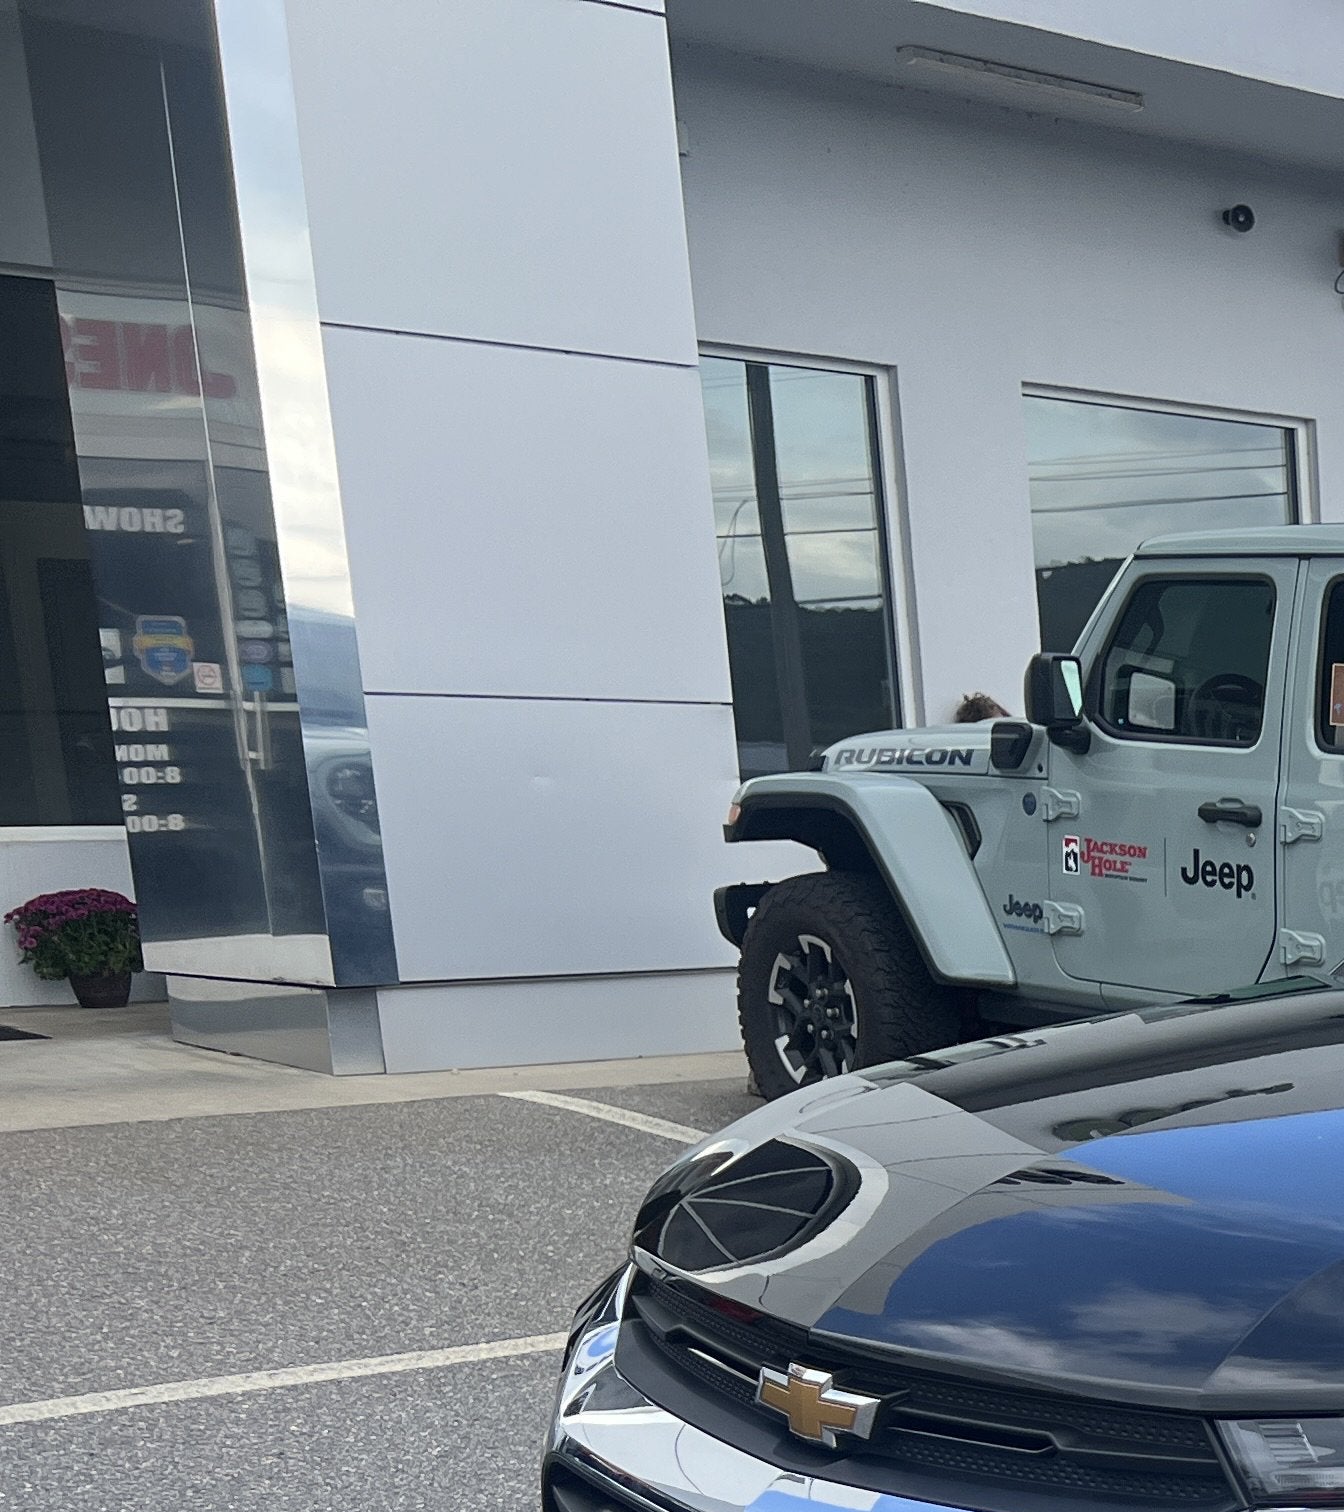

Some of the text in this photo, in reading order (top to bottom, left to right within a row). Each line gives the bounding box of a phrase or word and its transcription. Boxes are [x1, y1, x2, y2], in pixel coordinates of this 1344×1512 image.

[834, 748, 975, 766] RUBICON
[1080, 837, 1148, 863] JACKSON
[1090, 856, 1130, 877] HOLE
[1181, 849, 1254, 899] Jeep
[1003, 894, 1043, 924] Jeep
